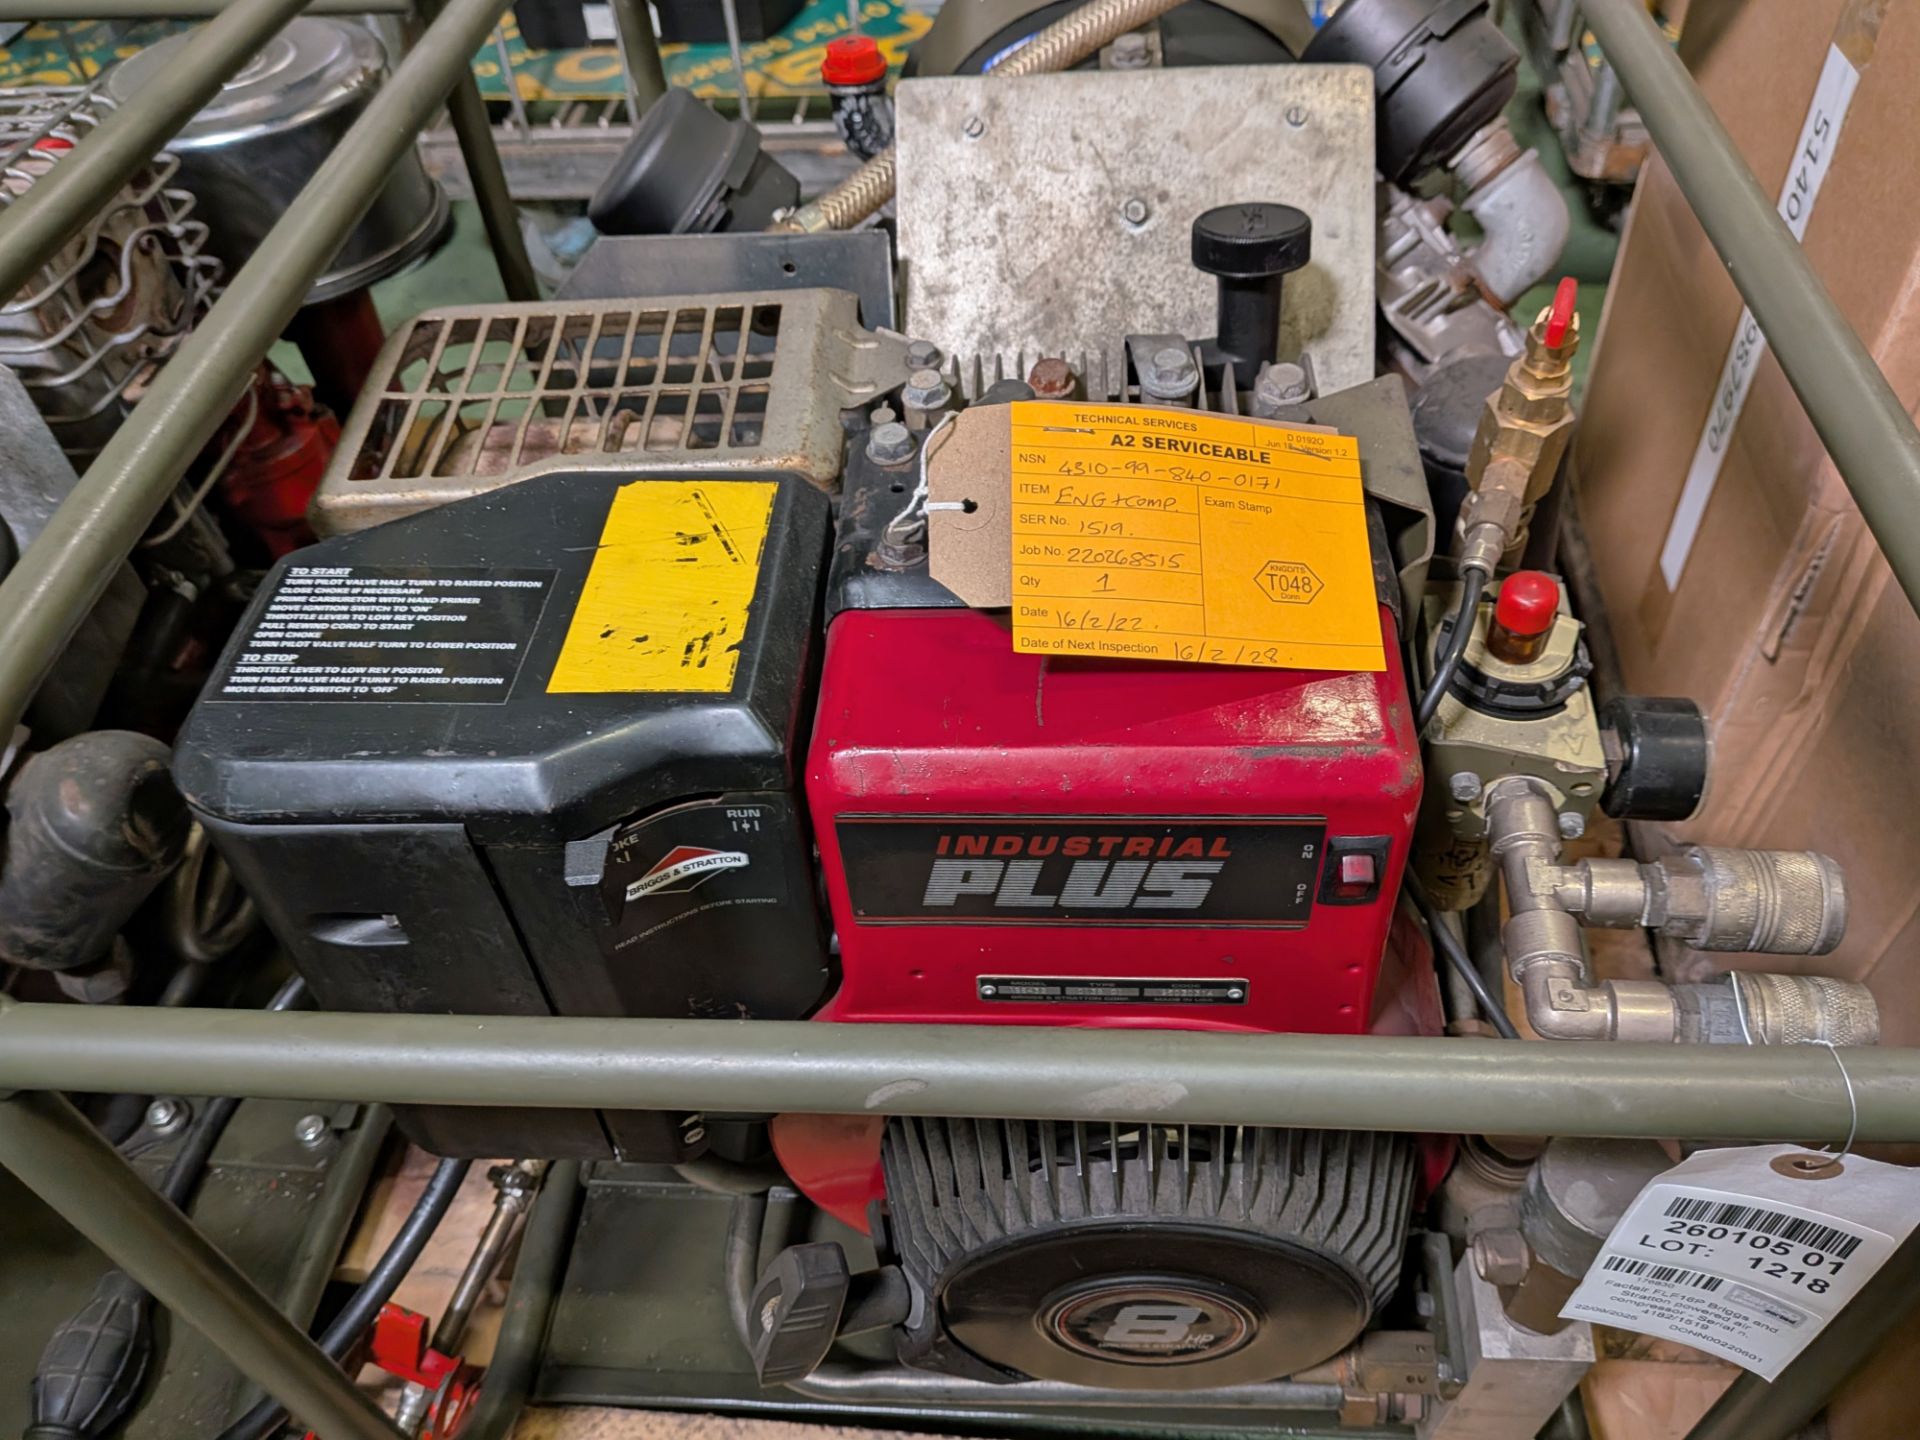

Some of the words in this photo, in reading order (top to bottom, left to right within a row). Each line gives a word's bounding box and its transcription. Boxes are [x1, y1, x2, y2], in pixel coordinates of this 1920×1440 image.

[1787, 109, 1830, 221] 5140
[1074, 414, 1140, 425] TECHNICAL
[1143, 417, 1198, 432] SERVICES
[1286, 434, 1294, 442] D
[1111, 434, 1136, 448] A2
[1142, 436, 1272, 465] SERVICEABLE
[1266, 440, 1281, 448] Jun
[1335, 449, 1348, 457] 1.2
[1018, 454, 1046, 465] NSN
[1019, 483, 1050, 494] ITEM
[1054, 486, 1106, 506] ENG
[1204, 496, 1235, 509] Exam
[1238, 500, 1273, 515] Stamp
[1019, 514, 1046, 524] SER
[1049, 515, 1070, 526] No.
[1019, 545, 1042, 556] Job
[1043, 546, 1065, 557] No.
[290, 567, 309, 576] TO
[310, 567, 353, 576] START
[284, 578, 314, 586] TURN
[314, 578, 343, 586] PILOT
[344, 578, 378, 586] VALVE
[379, 578, 407, 586] HALF
[408, 579, 437, 587] TURN
[438, 579, 454, 587] TO
[454, 579, 493, 587] RAISED
[493, 579, 543, 587] POSITION
[1019, 575, 1041, 588] Qty
[1092, 573, 1117, 592] 1
[1265, 573, 1313, 594] T048
[264, 613, 316, 621] THROTTLE
[317, 613, 351, 621] LEVER
[352, 613, 367, 621] TO
[368, 613, 393, 621] LOW
[394, 613, 416, 621] REV
[416, 614, 468, 622] POSITION
[1020, 606, 1048, 617] Date
[259, 622, 285, 630] PULL
[330, 622, 362, 630] CORD
[363, 622, 380, 630] TO
[380, 622, 415, 630] START
[253, 631, 284, 639] OPEN
[285, 631, 323, 639] CHOKE
[250, 640, 279, 648] TURN
[280, 640, 311, 648] PILOT
[312, 640, 347, 648] VALVE
[348, 640, 377, 648] HALF
[377, 640, 407, 648] TURN
[410, 641, 426, 649] TO
[426, 641, 464, 649] LOWER
[465, 641, 517, 649] POSITION
[1020, 637, 1049, 649] Date
[1052, 638, 1065, 649] of
[1067, 639, 1096, 650] Next
[1099, 641, 1159, 655] Inspection
[241, 654, 261, 662] TO
[261, 654, 299, 662] STOP
[234, 666, 289, 674] THROTTLE
[290, 666, 324, 674] LEVER
[324, 666, 340, 674] TO
[341, 666, 367, 674] LOW
[367, 666, 391, 674] REV
[391, 666, 444, 674] POSITION
[229, 676, 259, 684] TURN
[260, 676, 292, 684] PILOT
[293, 676, 329, 684] VALVE
[329, 676, 359, 684] HALF
[360, 676, 391, 684] TURN
[393, 676, 409, 684] TO
[409, 676, 450, 684] RAISED
[451, 676, 504, 684] POSITION
[726, 809, 761, 818] RUN
[936, 835, 1233, 858] INDUSTRIAL
[1302, 844, 1314, 859] ON
[628, 870, 672, 896] BRIGGS
[673, 867, 681, 876] &
[683, 855, 742, 872] STRATTON
[922, 858, 1226, 909] PLUS
[1295, 883, 1307, 904] OFF
[639, 907, 699, 938] INSTRUCTIONS
[699, 899, 733, 911] BEFORE
[734, 897, 778, 905] STARTING
[1663, 1219, 1795, 1256] 260105
[1801, 1251, 1845, 1276] 01
[1638, 1234, 1715, 1257] LOT:
[1747, 1256, 1831, 1294] 1218
[1604, 1279, 1650, 1292] Factair
[1707, 1302, 1750, 1322] Briggs
[1752, 1320, 1779, 1334] and
[1609, 1295, 1686, 1315] compressor
[1697, 1315, 1736, 1332] Serial
[1620, 1290, 1672, 1305] Stratton
[1673, 1302, 1731, 1322] powered
[1733, 1321, 1752, 1330] air
[1103, 1305, 1203, 1343] 8
[1185, 1333, 1215, 1345] HP
